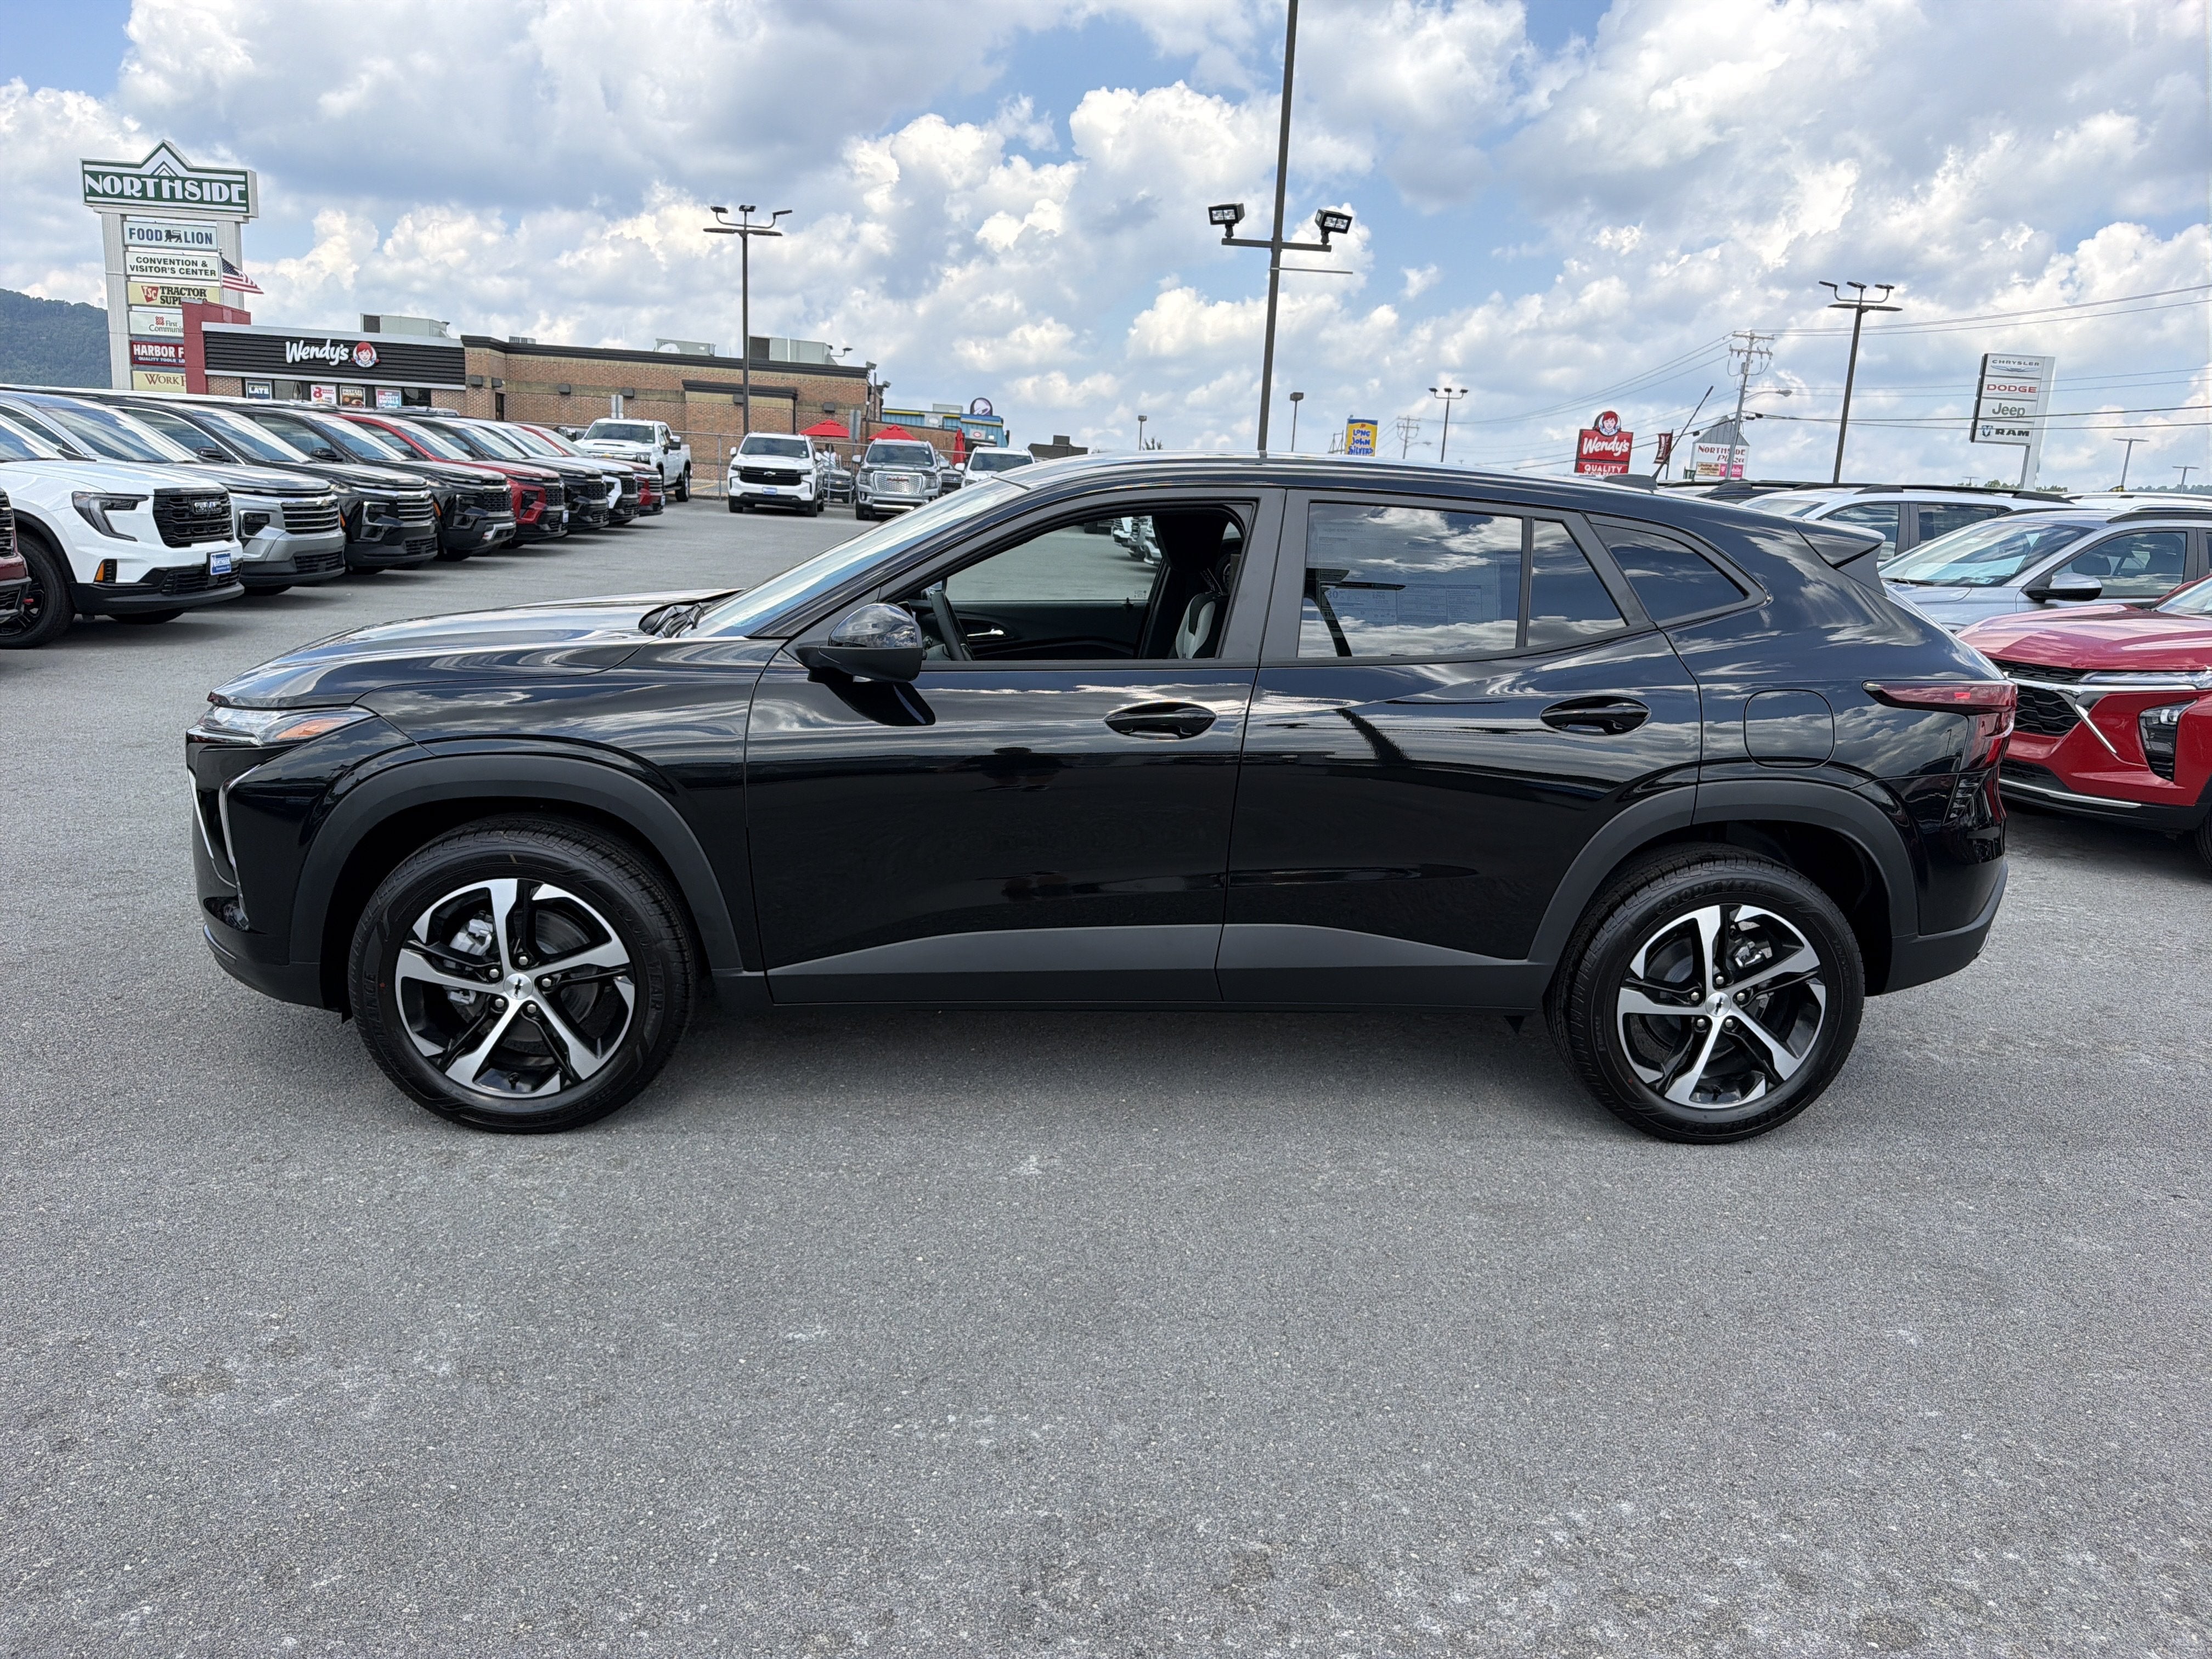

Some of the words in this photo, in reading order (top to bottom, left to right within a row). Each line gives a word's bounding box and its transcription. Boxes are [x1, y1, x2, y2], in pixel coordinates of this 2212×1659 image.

[84, 173, 246, 203] NORTHSIDE
[129, 228, 162, 241] FOOD
[184, 231, 213, 245] LION
[136, 256, 198, 267] CONVENTION
[129, 264, 176, 274] VISITOR'S
[179, 268, 216, 276] CENTER
[142, 286, 157, 300] TSC
[160, 286, 207, 297] TRACTOR
[133, 344, 175, 357] HARBOR
[285, 339, 349, 366] Wendy's
[1987, 384, 2037, 393] DODGE
[1992, 403, 2025, 417] Jeep
[1995, 428, 2030, 437] RAM
[1583, 436, 1629, 456] Wendy's
[1584, 464, 1622, 473] QUALITY
[194, 501, 222, 514] GMC
